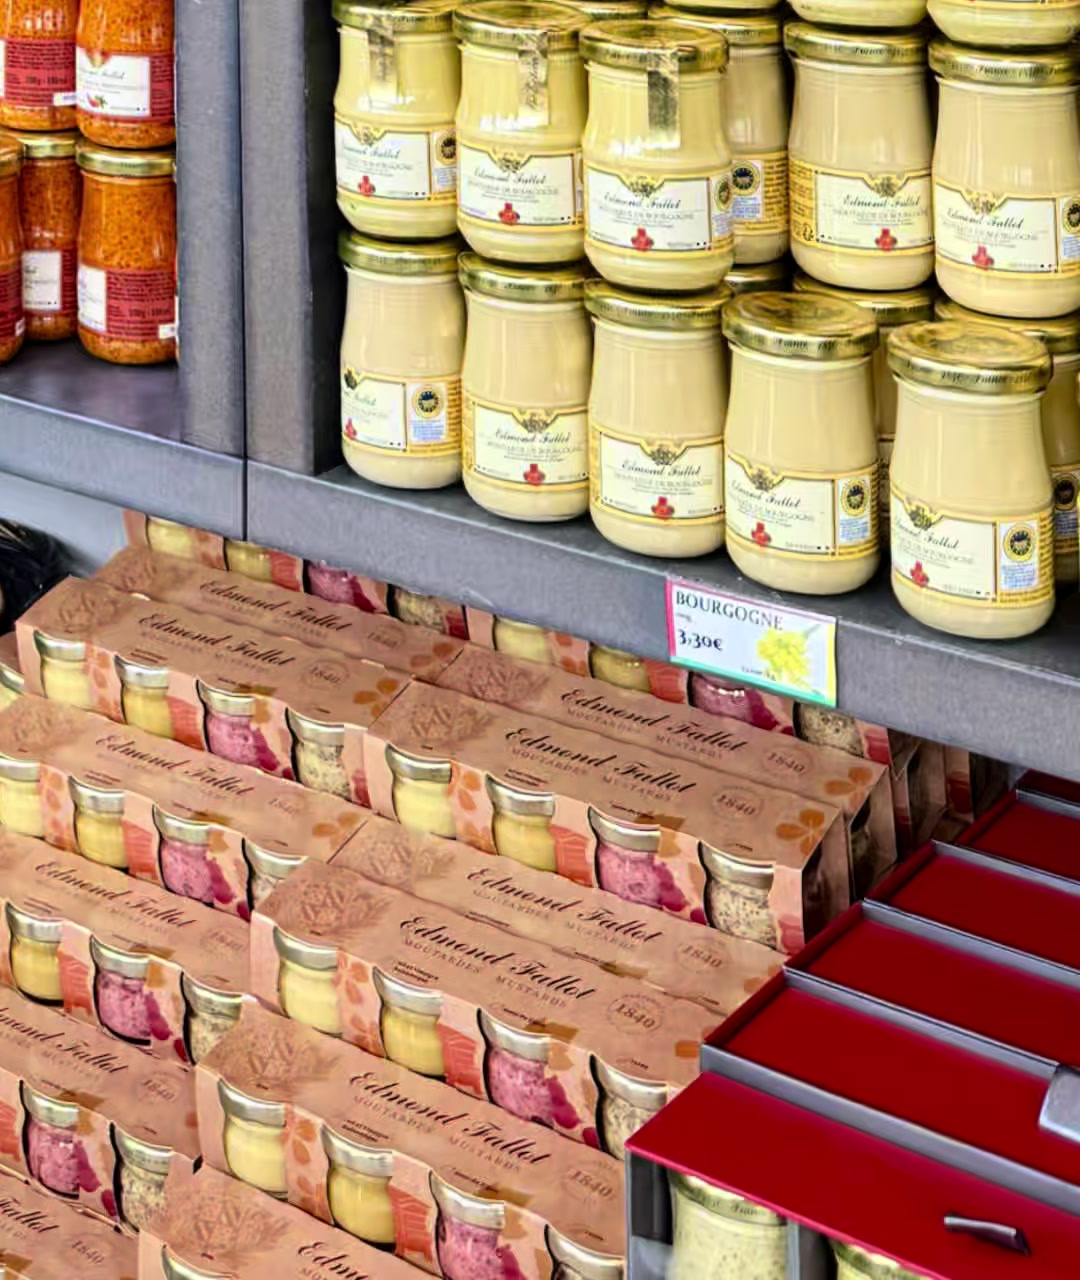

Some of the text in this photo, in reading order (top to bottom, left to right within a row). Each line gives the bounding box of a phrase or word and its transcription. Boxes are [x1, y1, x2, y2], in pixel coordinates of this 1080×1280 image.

[199, 576, 355, 633] Edmond Fallot
[675, 590, 784, 631] BOURGOGNE
[137, 612, 297, 669] Edmond Fallot
[677, 628, 724, 652] 3,30€
[560, 689, 749, 754] Edmond Fallot
[95, 734, 256, 797] Edmond Fallot
[504, 727, 699, 796] Edmond Fallot
[717, 793, 758, 818] 1840
[34, 859, 198, 930] Edmond Fallot
[466, 867, 666, 944] Edmond Fallot
[399, 915, 597, 1001] Edmond Fallot
[612, 1001, 659, 1031] 1840
[56, 1038, 130, 1075] Fallot
[349, 1070, 552, 1166] Edmond Fallot
[567, 1168, 614, 1201] 1840
